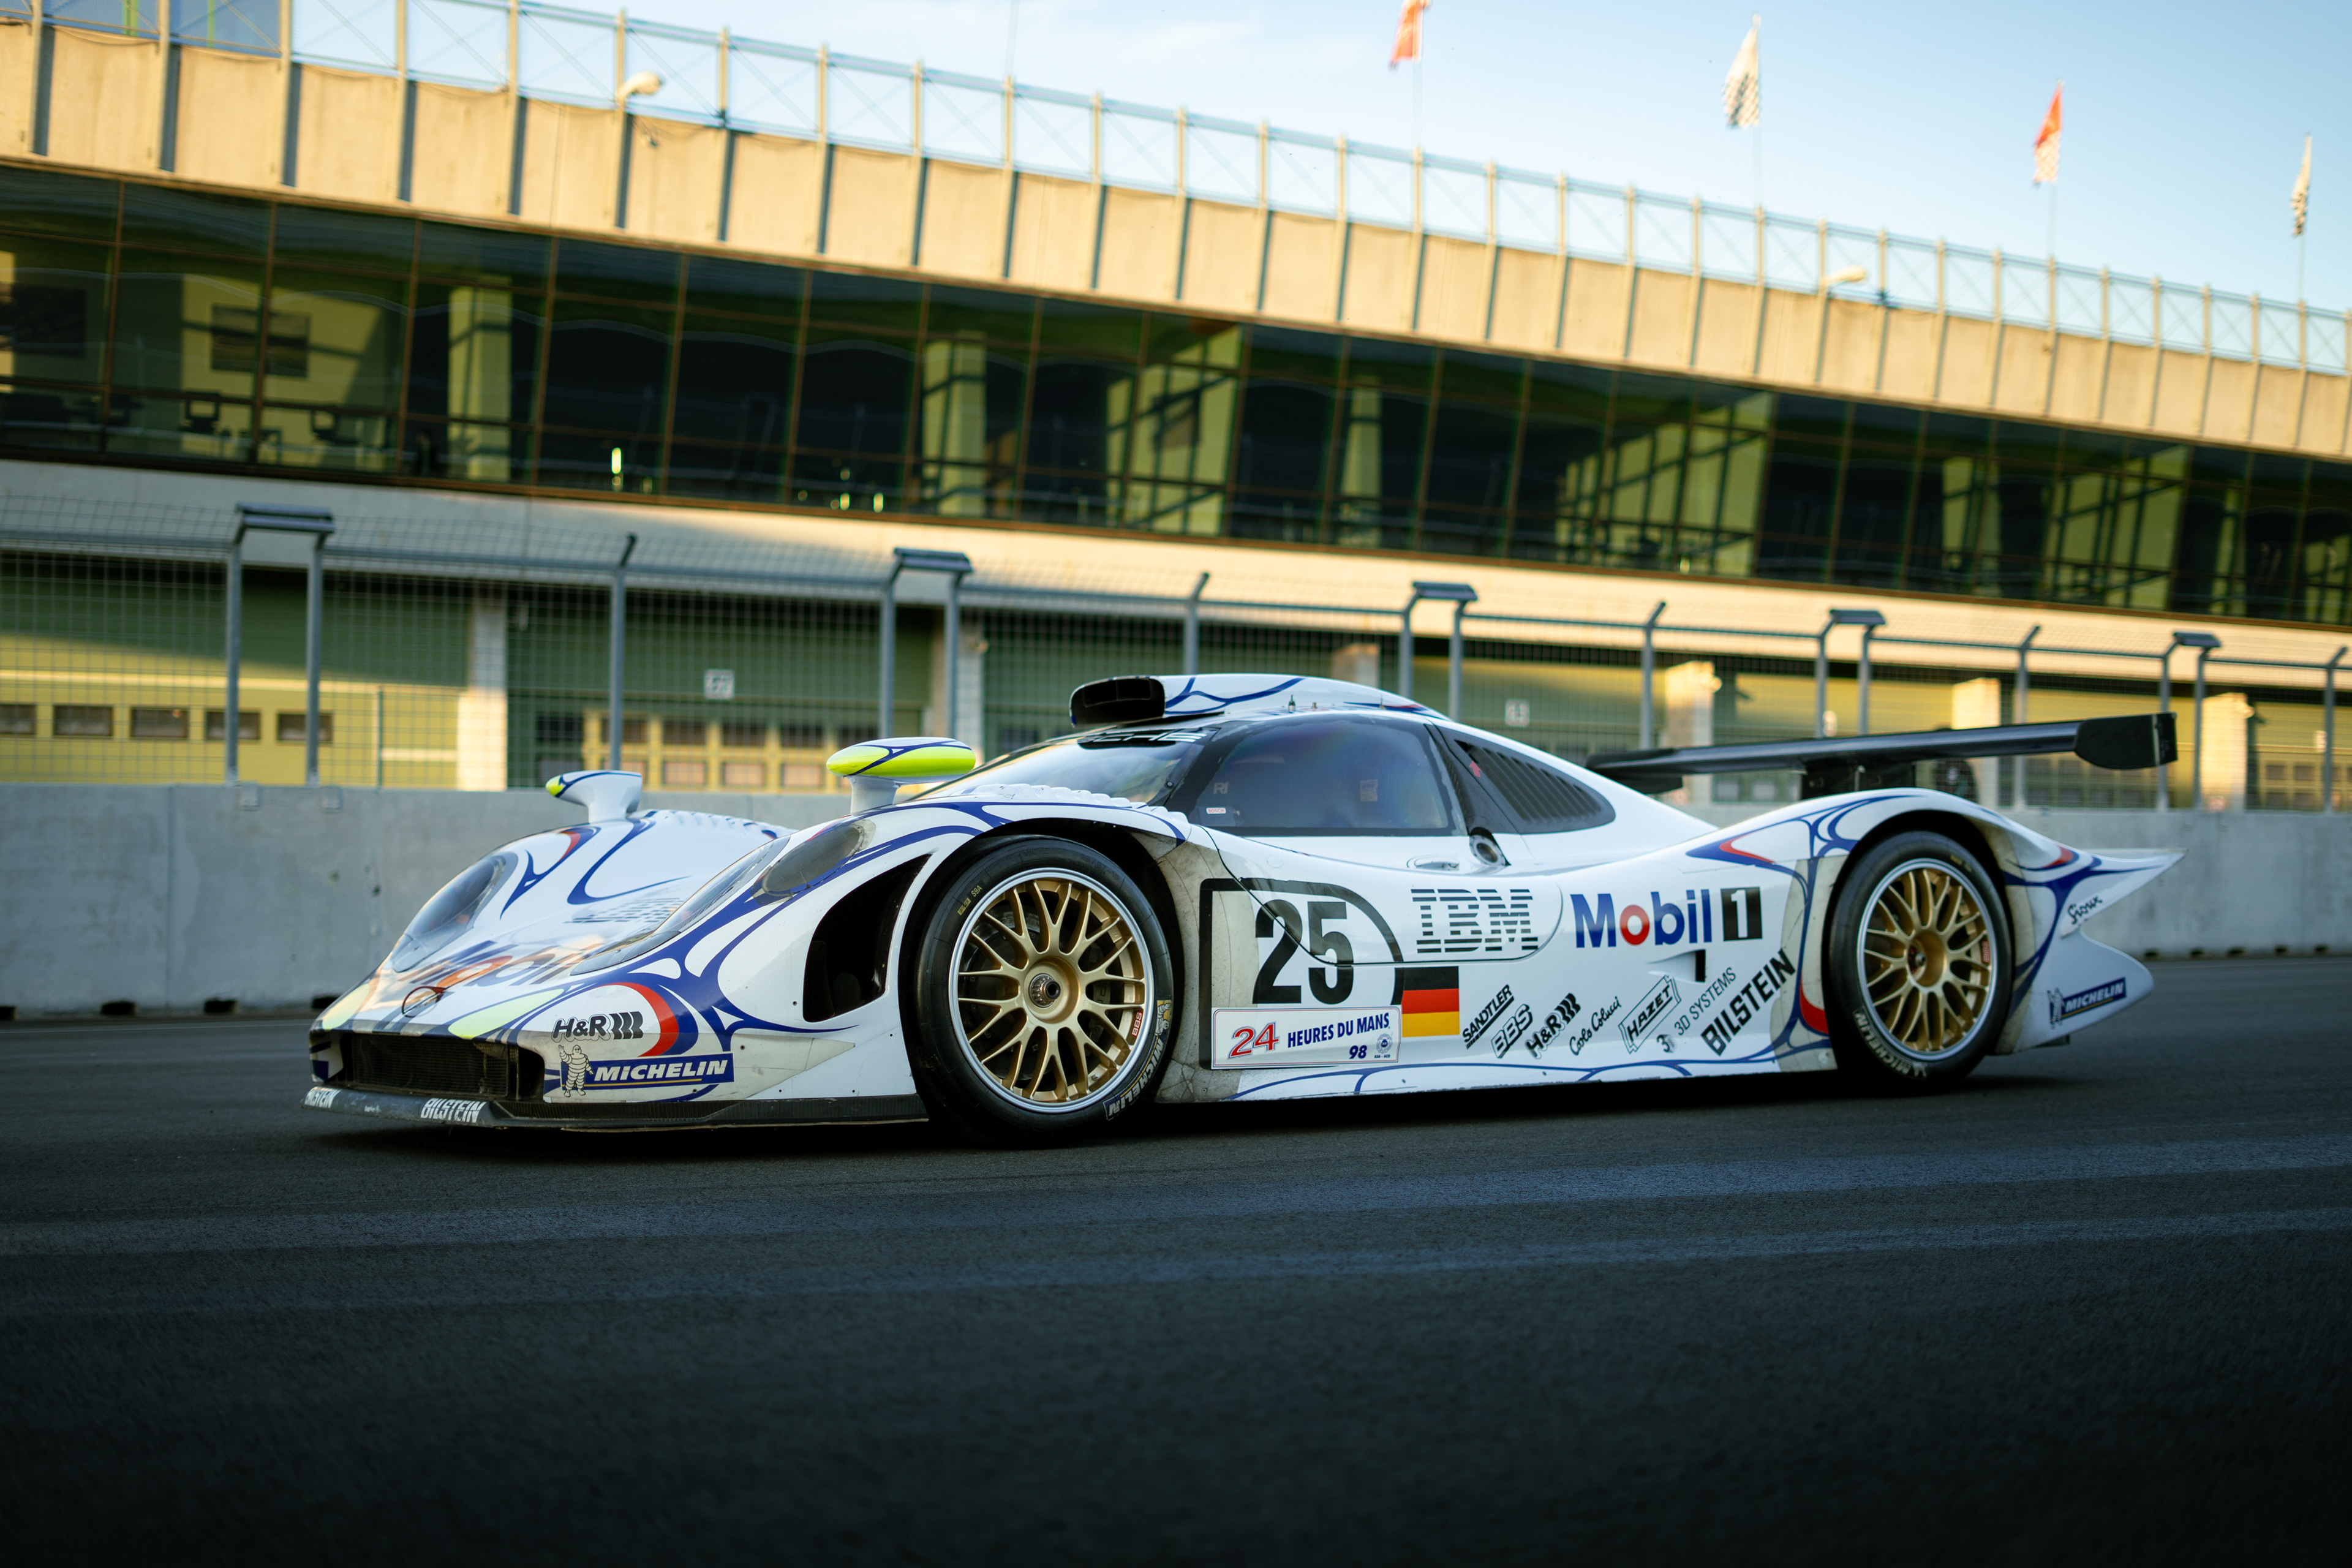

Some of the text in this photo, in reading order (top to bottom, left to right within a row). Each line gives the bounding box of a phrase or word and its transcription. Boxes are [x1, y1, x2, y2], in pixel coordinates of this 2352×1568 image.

[971, 884, 983, 897] S9A
[1411, 888, 1539, 954] IBM
[1570, 889, 1713, 949] Mobil
[1252, 899, 1354, 1005] 25
[1462, 984, 1512, 1043] SANDTLER
[1591, 996, 1622, 1032] Colucci
[1627, 984, 1670, 1043] HAZET
[1673, 1014, 1691, 1036] 3D
[1689, 967, 1736, 1020] SYSTEMS
[1700, 948, 1796, 1057] BILSTEIN
[2065, 981, 2125, 1012] MICHELIN
[552, 1014, 609, 1041] H&R
[1132, 1011, 1142, 1036] BBS
[1227, 1012, 1389, 1060] 24 HEURES DU MANS
[1491, 1003, 1533, 1059] BBS
[1525, 1013, 1564, 1059] H&R
[1854, 1012, 1912, 1075] MICHELIN
[594, 1060, 728, 1082] MICHELIN
[1109, 1038, 1164, 1117] MICHELIN
[1349, 1045, 1367, 1060] 98
[420, 1098, 486, 1123] BILSTEIN
